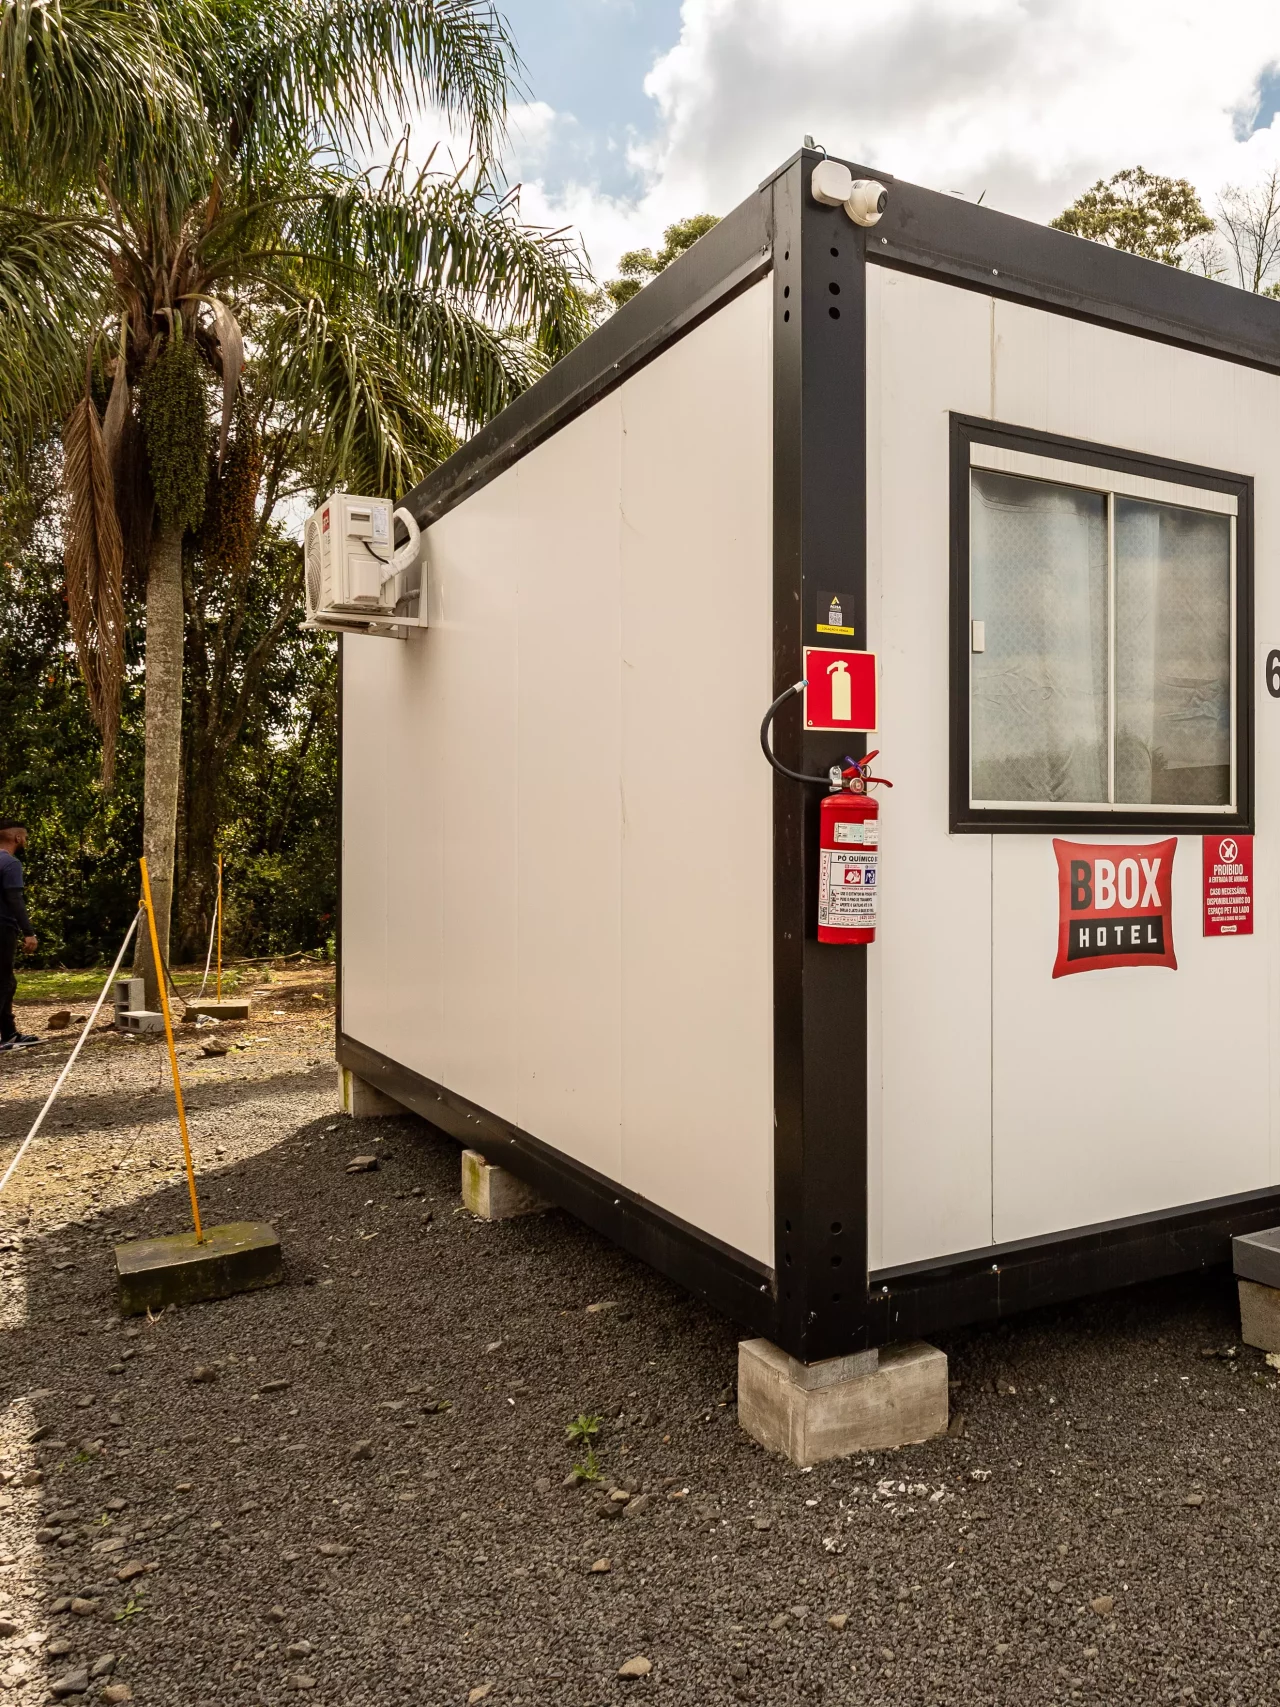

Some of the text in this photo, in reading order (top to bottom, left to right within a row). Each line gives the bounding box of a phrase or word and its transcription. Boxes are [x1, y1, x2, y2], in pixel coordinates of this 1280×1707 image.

[837, 854, 847, 862] PÓ
[1213, 864, 1244, 876] PROIBIDO
[1070, 858, 1162, 911] BBOX
[1208, 905, 1250, 916] ESPAÇO PET AO LADO
[1079, 924, 1158, 948] HOTEL
